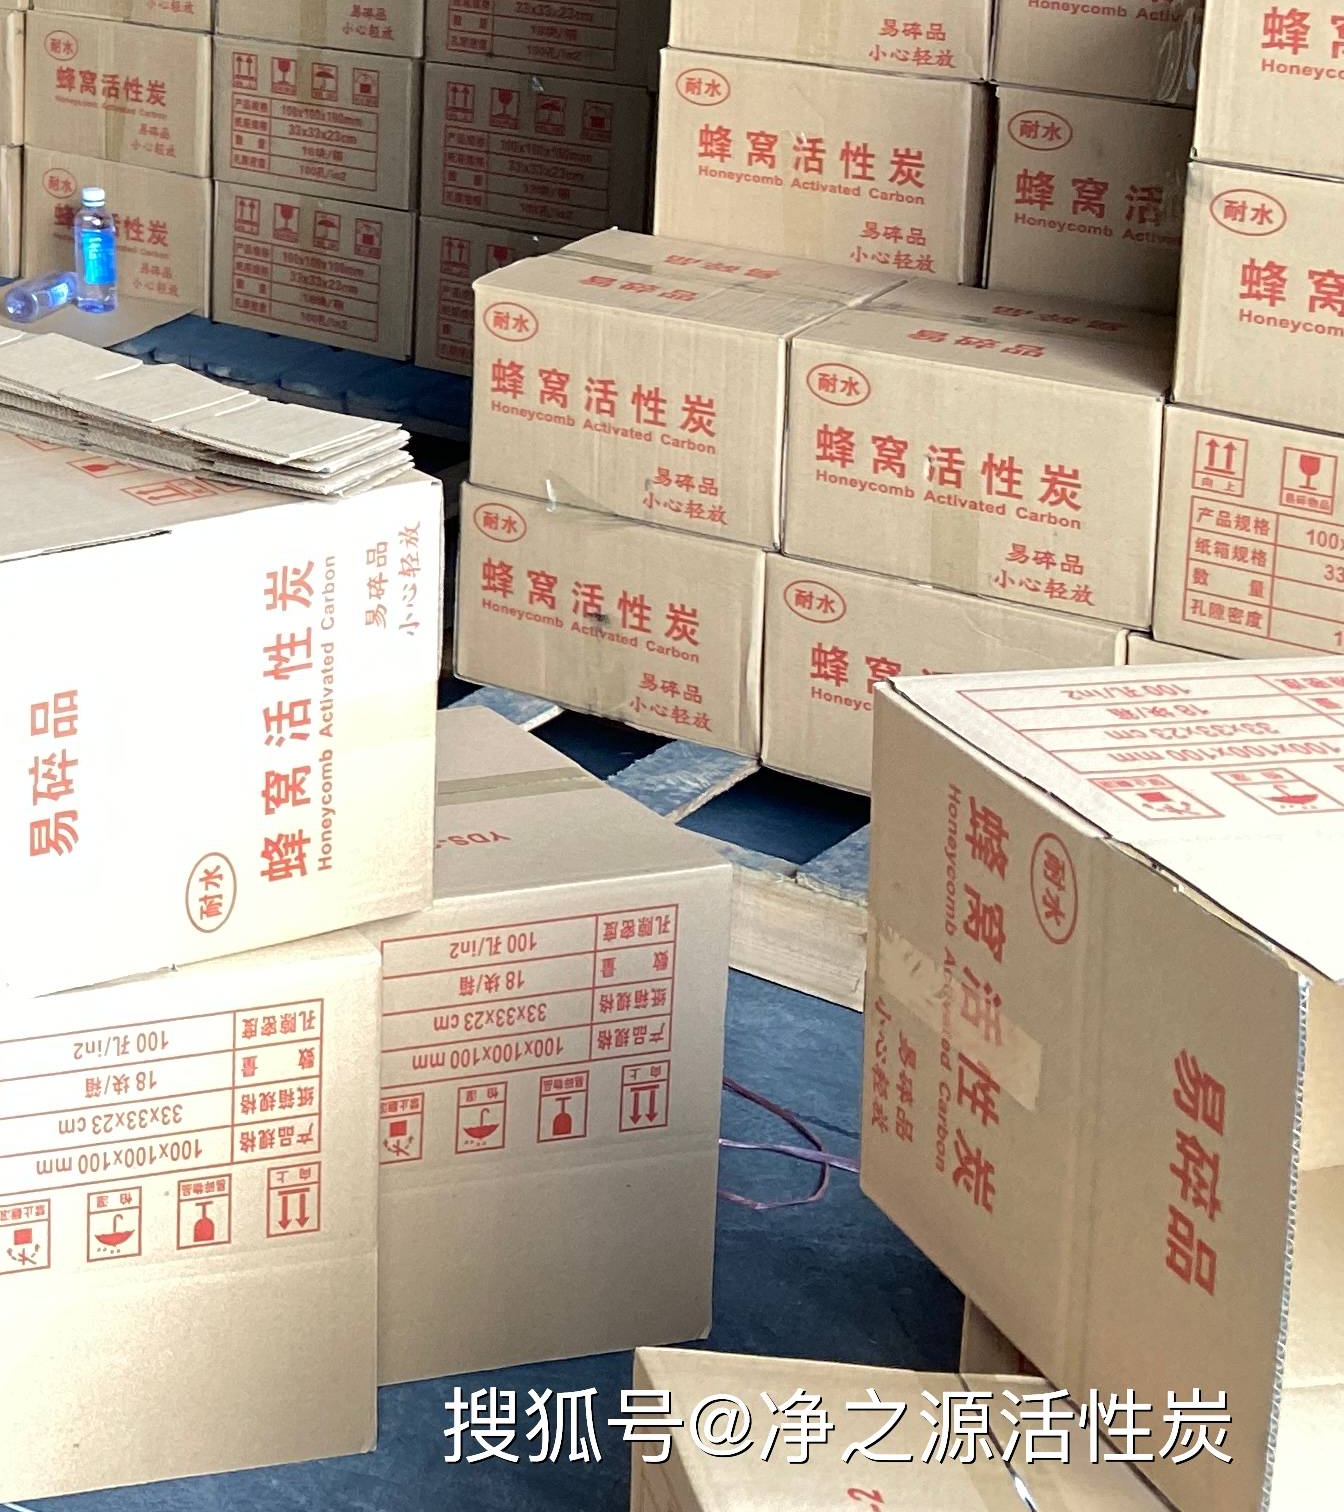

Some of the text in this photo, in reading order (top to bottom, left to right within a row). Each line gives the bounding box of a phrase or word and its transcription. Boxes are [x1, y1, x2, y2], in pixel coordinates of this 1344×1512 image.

[868, 45, 956, 68] 小心轻放
[699, 125, 926, 187] 蜂窝活性炭
[493, 311, 529, 334] 耐水
[491, 359, 717, 437] 蜂窝活性炭
[817, 372, 861, 397] 耐水
[491, 400, 716, 455] Honeycomb Activated Carbon
[816, 425, 1082, 510] 蜂窝活性炭
[816, 469, 1082, 530] Honeycomb Activated Carbon
[1006, 544, 1084, 576] 易碎品
[365, 542, 388, 629] 易碎品
[994, 570, 1095, 606] 小心轻放
[261, 560, 314, 881] 蜂窝活性炭
[317, 555, 336, 871] Honeycomb Activated Carbon
[28, 689, 79, 856] 易碎品
[437, 831, 512, 848] YDS-
[942, 783, 963, 938] Honeycomb
[199, 865, 223, 920] 耐水
[1041, 847, 1067, 926] 耐水
[507, 932, 537, 954] 100
[465, 1003, 547, 1028] 33x33x23
[952, 795, 1011, 1213] 蜂窝活性炭
[433, 1016, 459, 1031] cm
[136, 1030, 169, 1052] 100
[450, 1036, 564, 1068] 100x100x100
[412, 1054, 446, 1070] mm
[136, 1071, 157, 1091] 18
[59, 1117, 86, 1134] cm
[92, 1104, 183, 1136] 33x33x23
[36, 1159, 73, 1176] mm
[79, 1139, 203, 1172] 100x100x100
[1166, 1048, 1227, 1297] 易碎品
